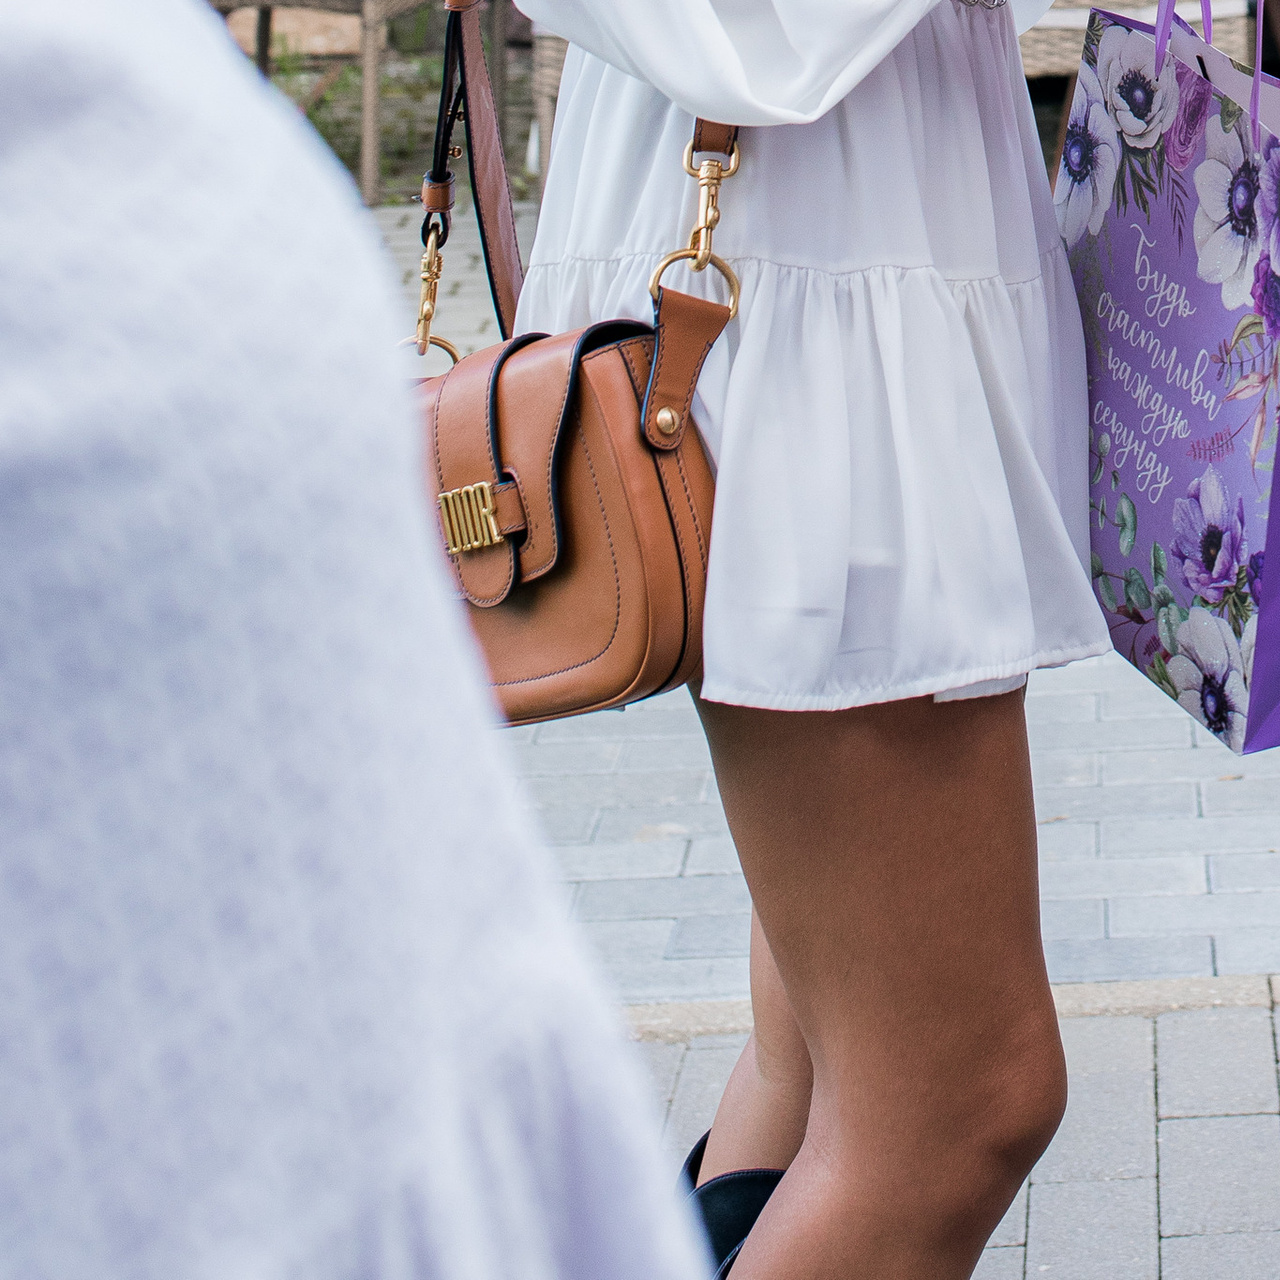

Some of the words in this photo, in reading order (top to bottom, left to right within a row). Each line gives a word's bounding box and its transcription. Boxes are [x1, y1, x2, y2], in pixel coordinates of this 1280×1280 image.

[1130, 223, 1197, 327] Будь
[1108, 347, 1191, 446] каждую
[1093, 400, 1173, 504] секунду
